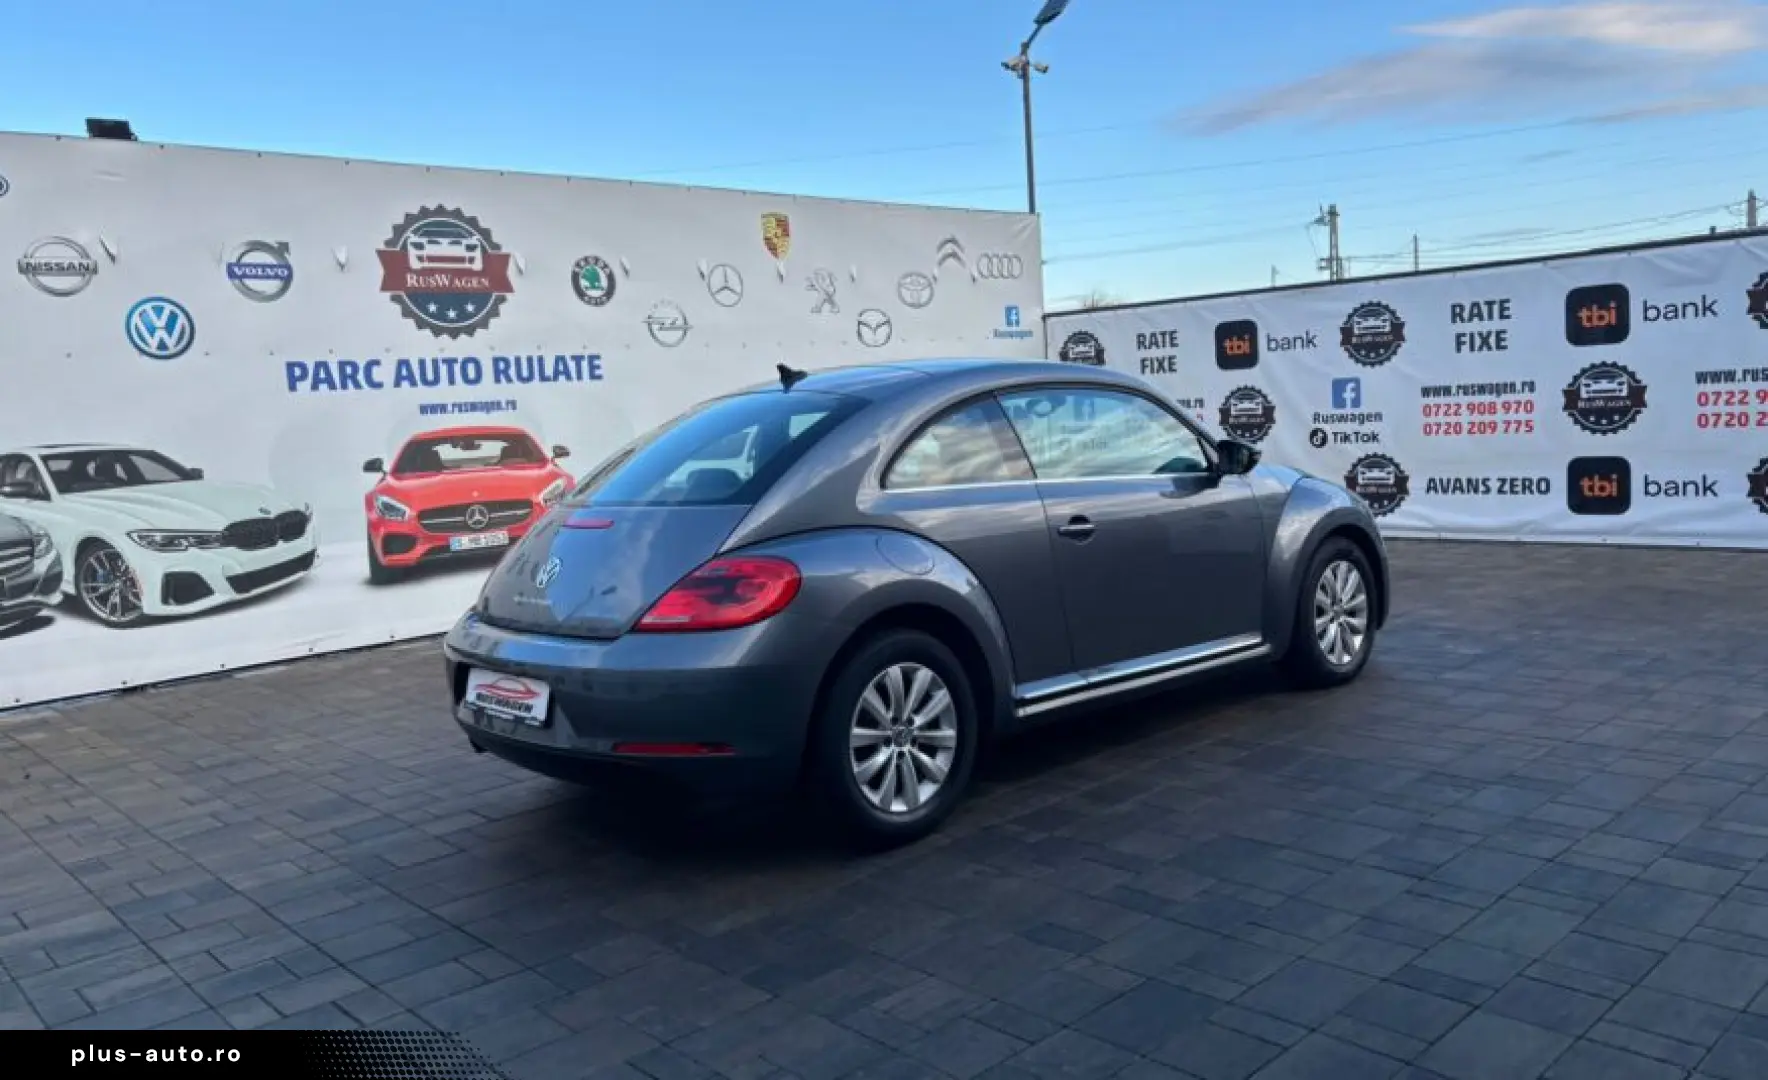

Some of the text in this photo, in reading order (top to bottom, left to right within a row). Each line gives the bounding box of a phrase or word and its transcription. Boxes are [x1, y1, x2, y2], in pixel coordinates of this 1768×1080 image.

[25, 262, 90, 273] NISSAN
[231, 266, 289, 278] VOLVO
[1450, 299, 1512, 324] RATE
[1577, 295, 1718, 327] tbi bank
[1136, 329, 1180, 351] RATE
[1223, 329, 1318, 355] tbi bank
[1454, 329, 1509, 353] FIXE
[285, 354, 604, 392] PARC AUTO RULATE
[1139, 355, 1178, 375] FIXE
[1421, 381, 1536, 399] www.ruswagen.ro
[1696, 389, 1749, 407] 0722
[419, 400, 517, 416] www.ruswagen.ro
[1422, 399, 1535, 418] 0722 908 970
[1312, 411, 1383, 426] Ruswagen
[1422, 419, 1535, 436] 0720 209 775
[1696, 412, 1749, 429] 0720
[1332, 430, 1380, 444] TikTok
[1425, 477, 1551, 496] AVANS ZERO
[1579, 473, 1719, 498] tbi bank
